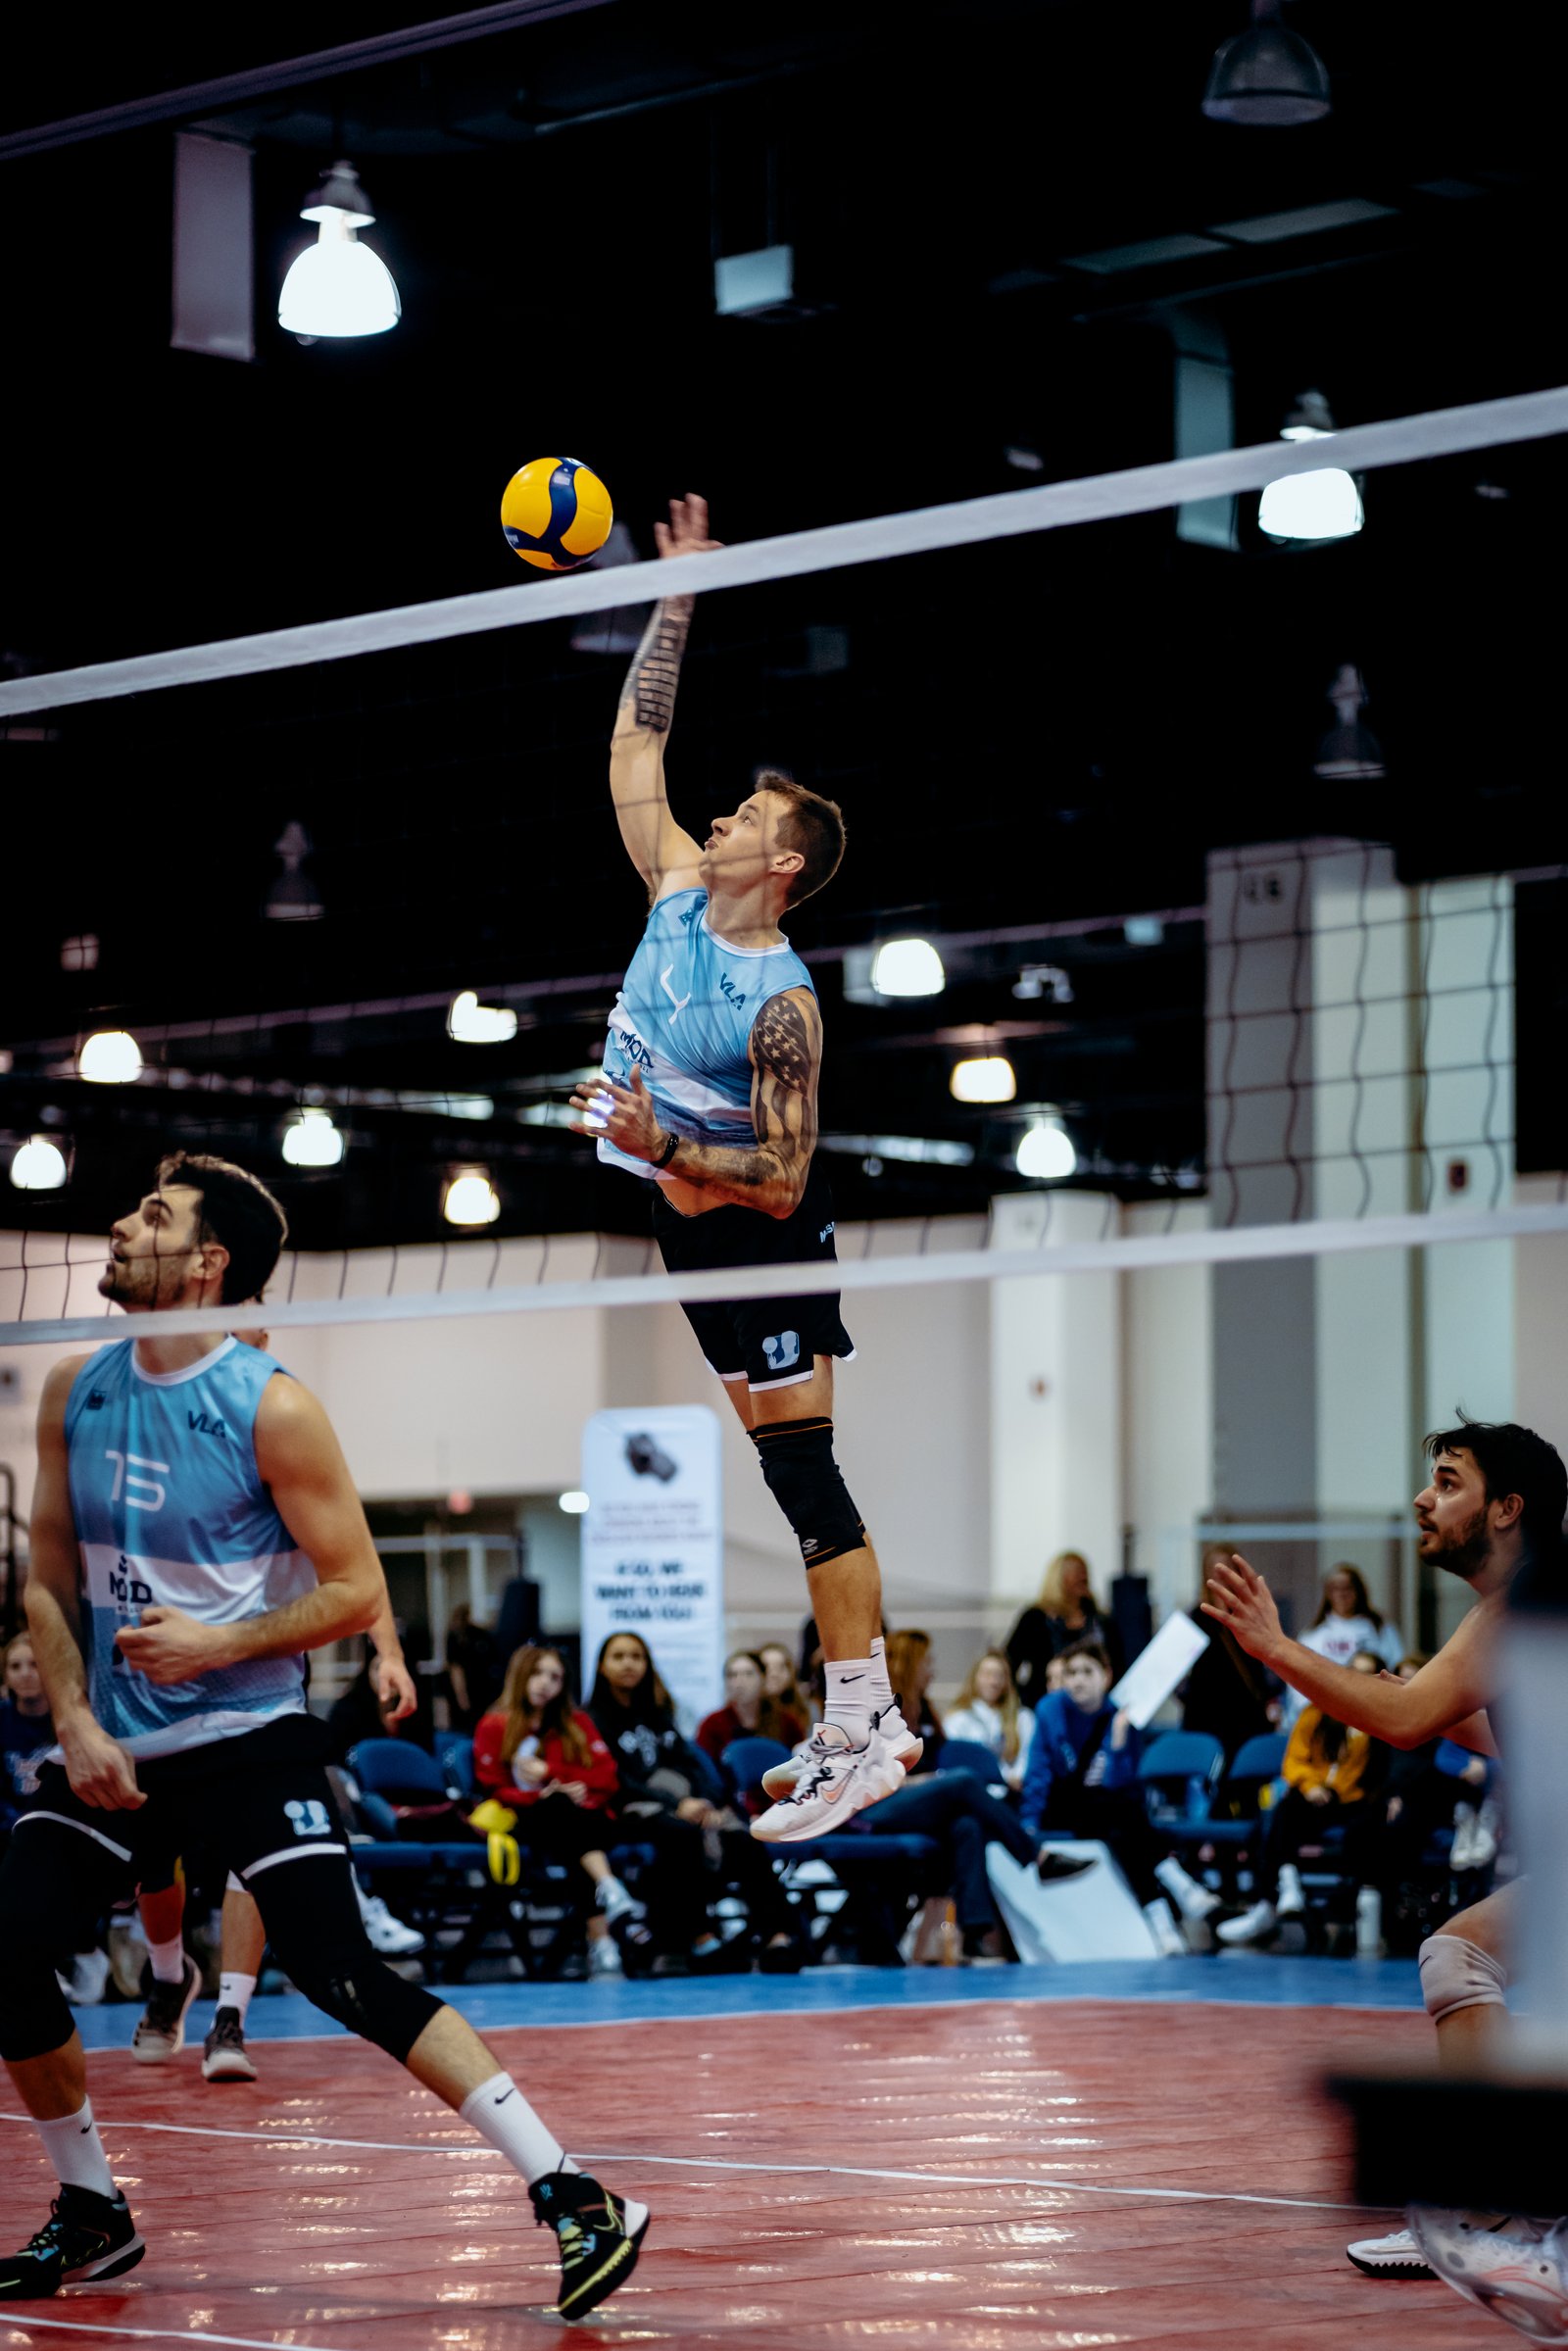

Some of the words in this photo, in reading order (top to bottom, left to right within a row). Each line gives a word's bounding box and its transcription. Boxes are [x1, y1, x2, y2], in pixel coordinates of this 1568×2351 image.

[720, 972, 746, 1010] VLA
[187, 1410, 225, 1438] VLA
[105, 1450, 170, 1511] 15
